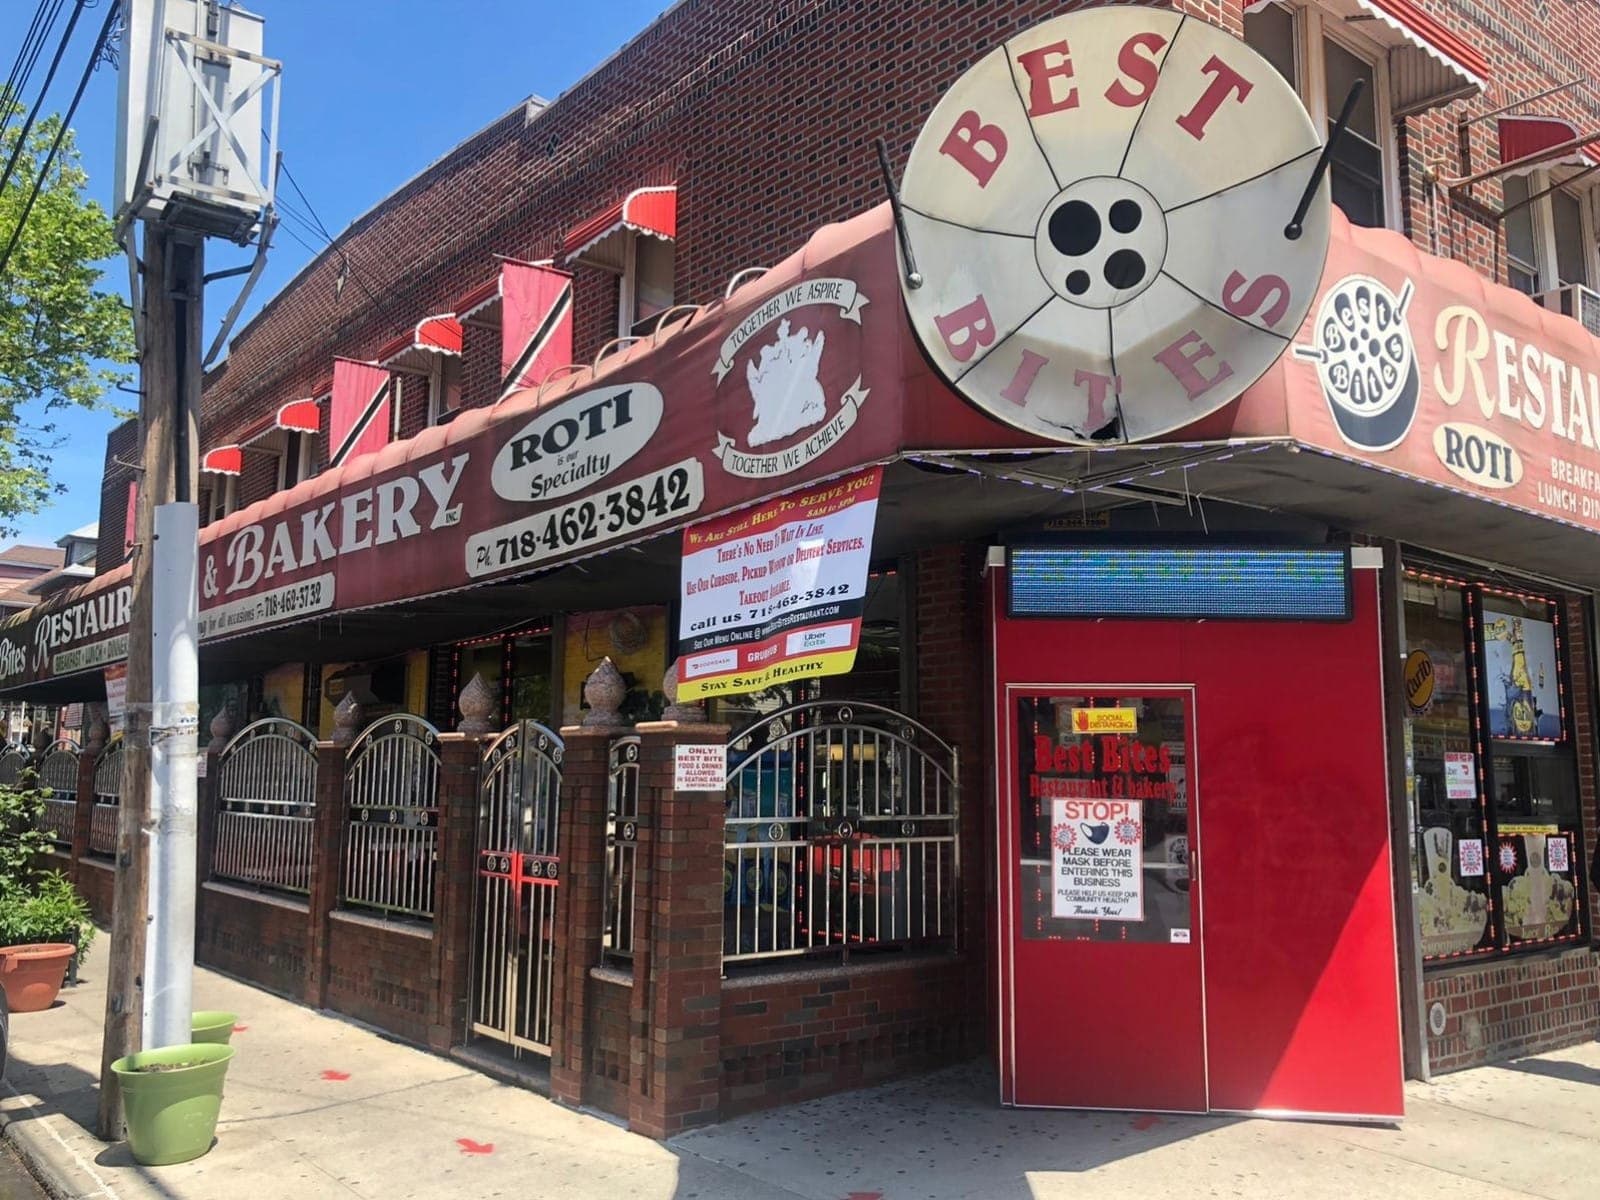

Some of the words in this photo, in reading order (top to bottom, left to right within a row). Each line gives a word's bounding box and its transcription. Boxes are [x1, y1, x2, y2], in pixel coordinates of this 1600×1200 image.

[939, 32, 1254, 189] BEST
[730, 297, 781, 348] TOGETHER
[785, 285, 803, 308] WE
[807, 281, 843, 300] ASPIRE
[933, 270, 1291, 431] BITES
[510, 388, 633, 471] ROTI
[731, 453, 779, 474] TOGETHER
[783, 448, 801, 469] WE
[804, 415, 846, 459] ACHIEVE
[557, 455, 564, 466] is
[1444, 426, 1514, 483] ROTI
[530, 453, 611, 499] Specialty
[799, 484, 843, 507] SERVE
[846, 474, 875, 493] YOU!
[1537, 480, 1577, 513] LUNCH
[203, 555, 220, 599] &
[225, 452, 470, 595] BAKERY
[690, 616, 717, 632] call
[722, 612, 742, 623] us
[749, 583, 850, 619] 718-462-3842
[730, 629, 754, 643] ONLINE
[754, 628, 762, 640] @
[803, 631, 827, 641] Uber
[701, 681, 726, 692] STAY
[732, 676, 763, 688] SAFE
[772, 661, 823, 679] HEALTHY
[1089, 720, 1133, 729] DISTANCING
[1034, 734, 1094, 773] Best
[1101, 734, 1171, 773] Bites
[1064, 800, 1130, 820] STOP!
[1062, 847, 1099, 857] PLEASE
[1102, 848, 1132, 857] WEAR
[1062, 857, 1090, 867] MASK
[1092, 858, 1132, 868] BEFORE
[1061, 867, 1109, 877] ENTERING
[1111, 868, 1133, 878] THIS
[1073, 877, 1121, 888] BUSINESS
